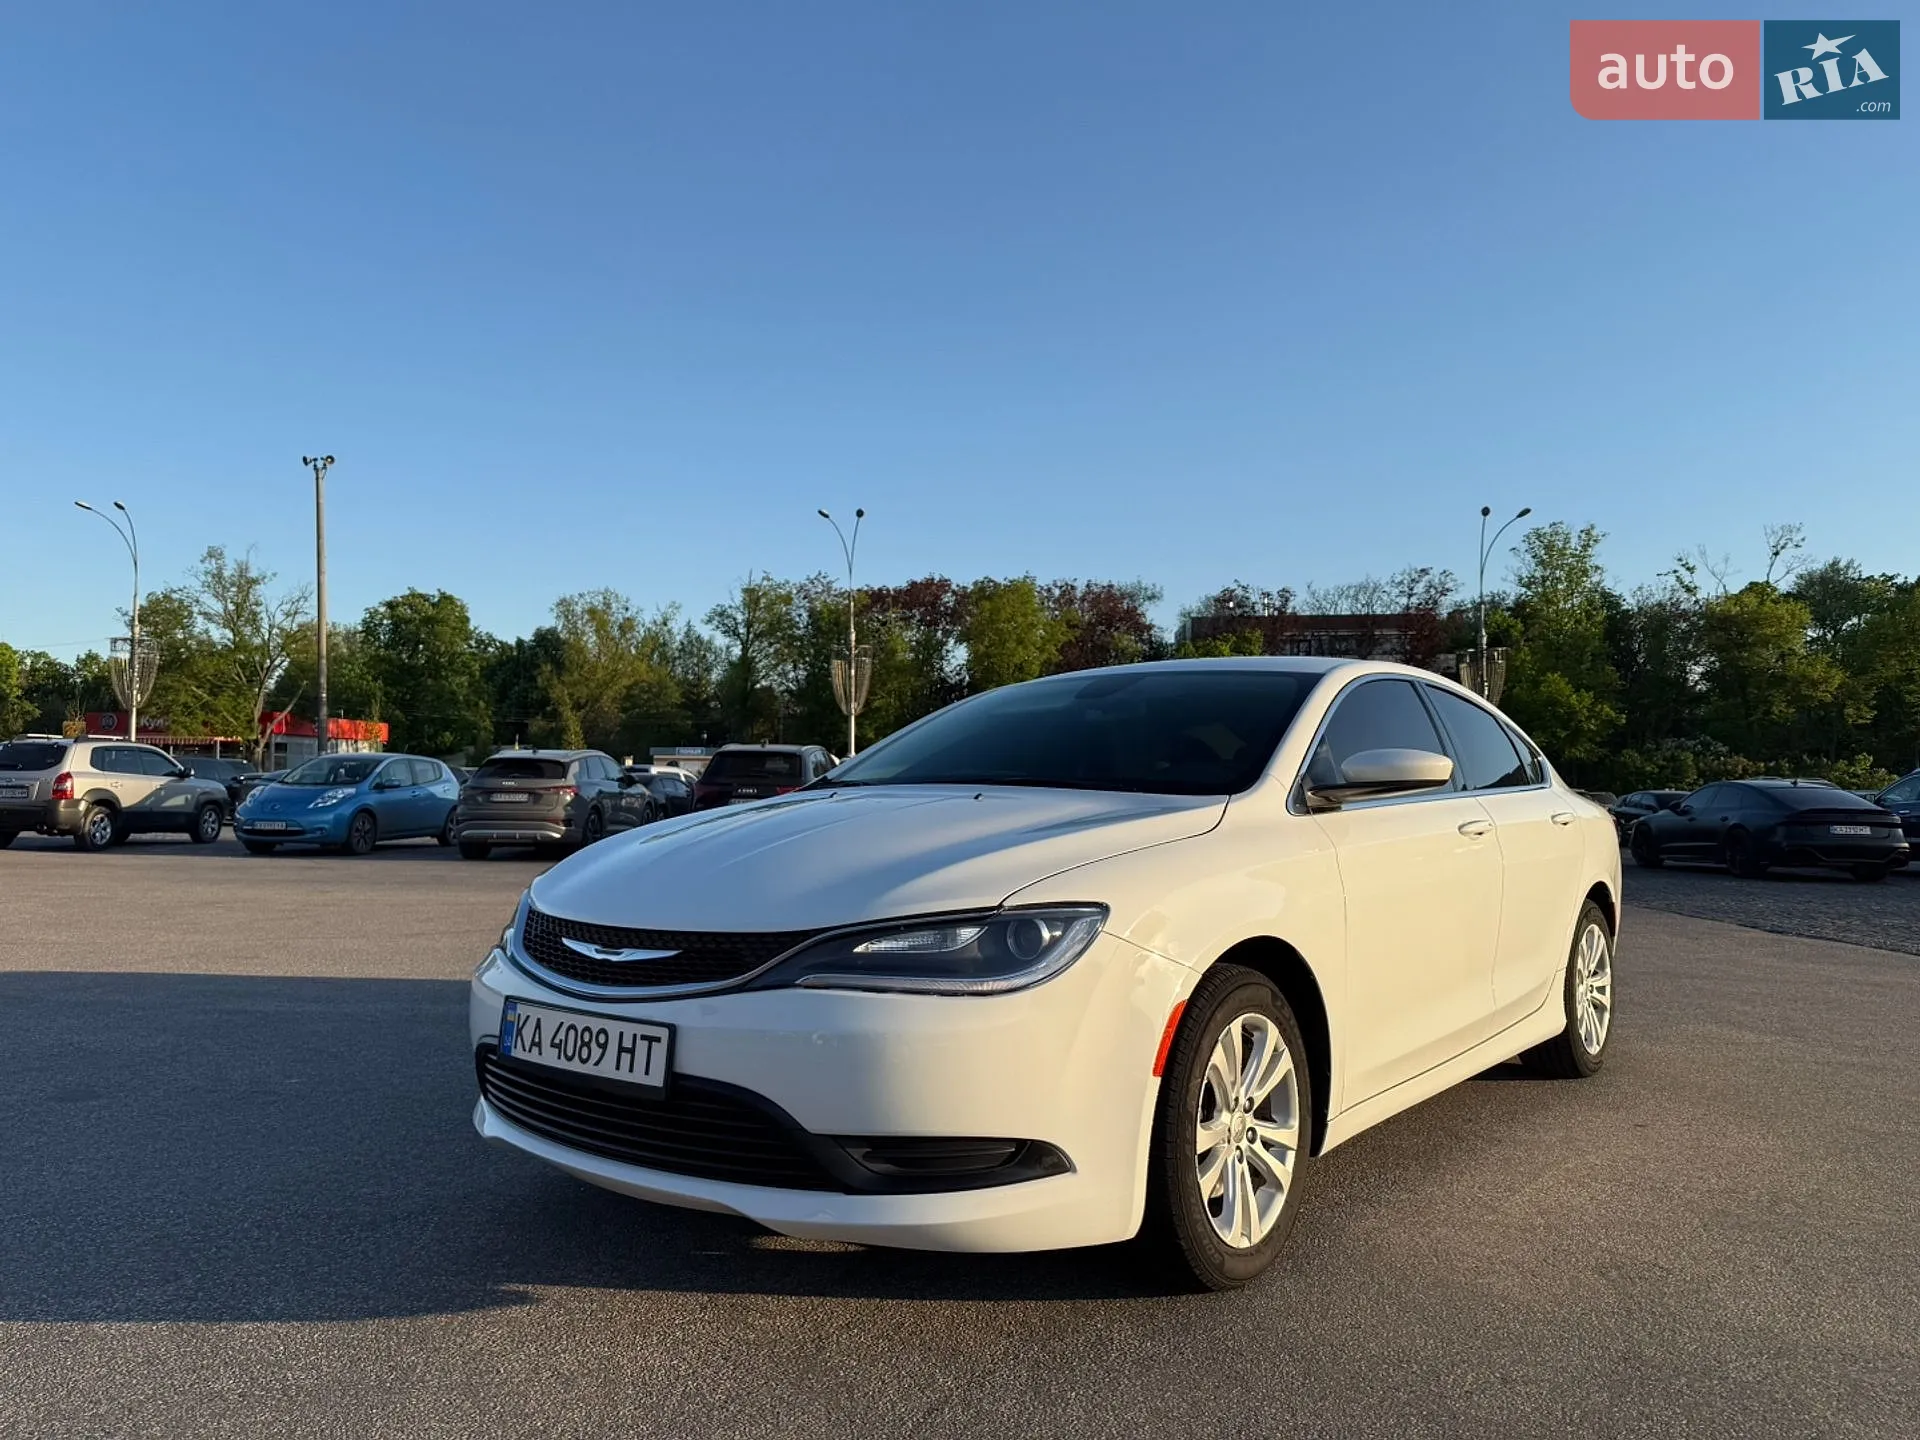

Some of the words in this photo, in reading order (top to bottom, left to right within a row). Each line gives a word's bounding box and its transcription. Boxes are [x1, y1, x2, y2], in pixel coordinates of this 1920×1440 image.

[514, 1013, 543, 1056] KA
[550, 1021, 610, 1066] 4089
[615, 1031, 662, 1076] HT
